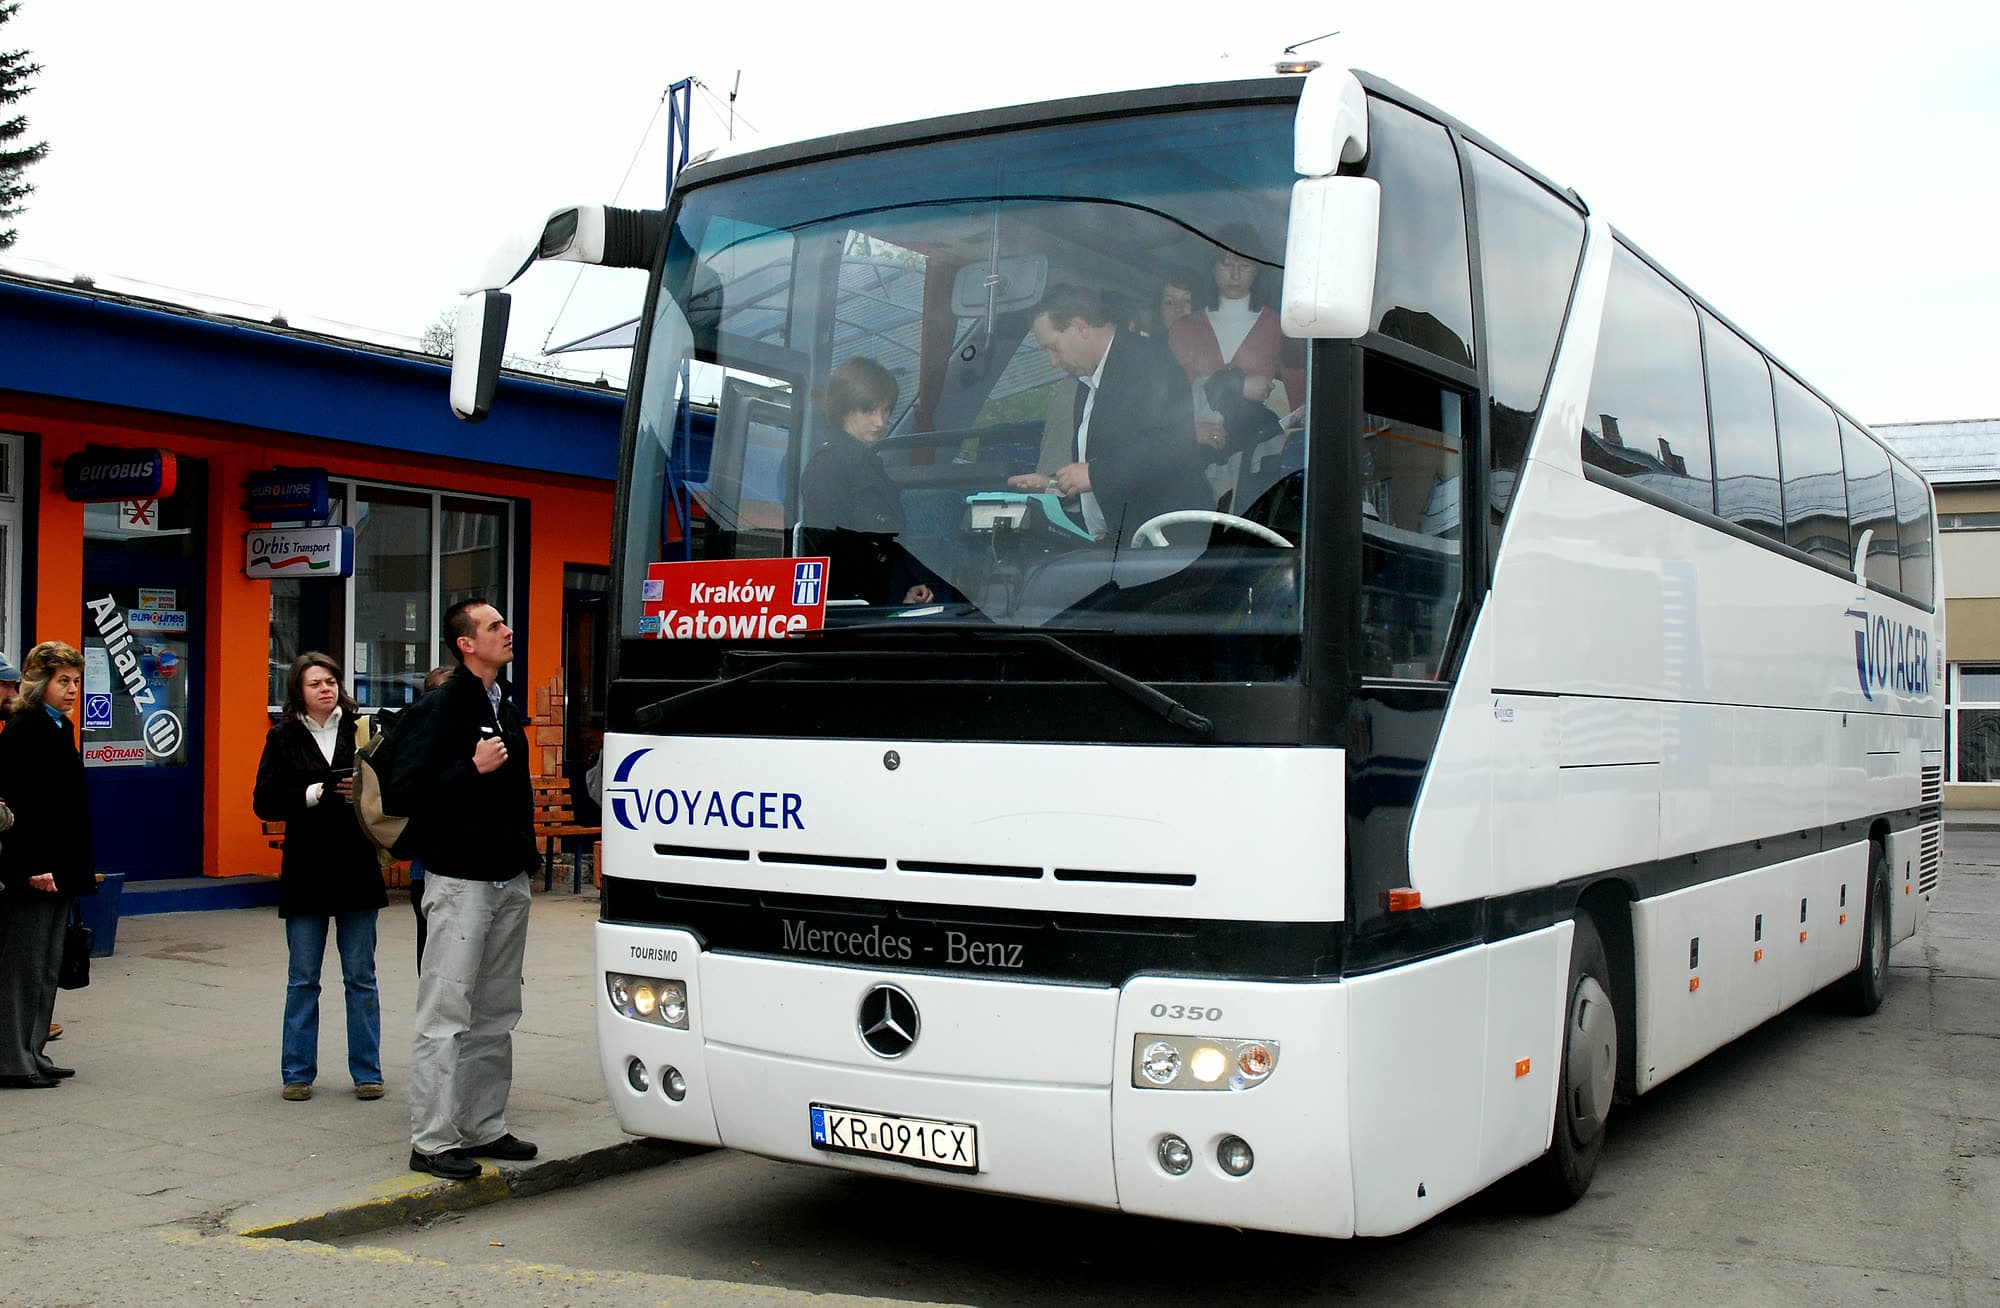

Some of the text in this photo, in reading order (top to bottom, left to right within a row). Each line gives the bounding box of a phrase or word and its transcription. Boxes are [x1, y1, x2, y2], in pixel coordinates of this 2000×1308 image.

[252, 536, 330, 556] Orbis Transport
[690, 578, 776, 604] Kraków
[656, 606, 808, 640] Katowice
[86, 593, 156, 713] Allianz
[1862, 611, 1929, 694] VOYAGER
[85, 745, 145, 762] EUROTRANS
[606, 788, 805, 830] VOYAGER
[630, 946, 678, 963] TOURISMO
[782, 919, 912, 960] Mercedes
[945, 931, 1024, 968] Benz
